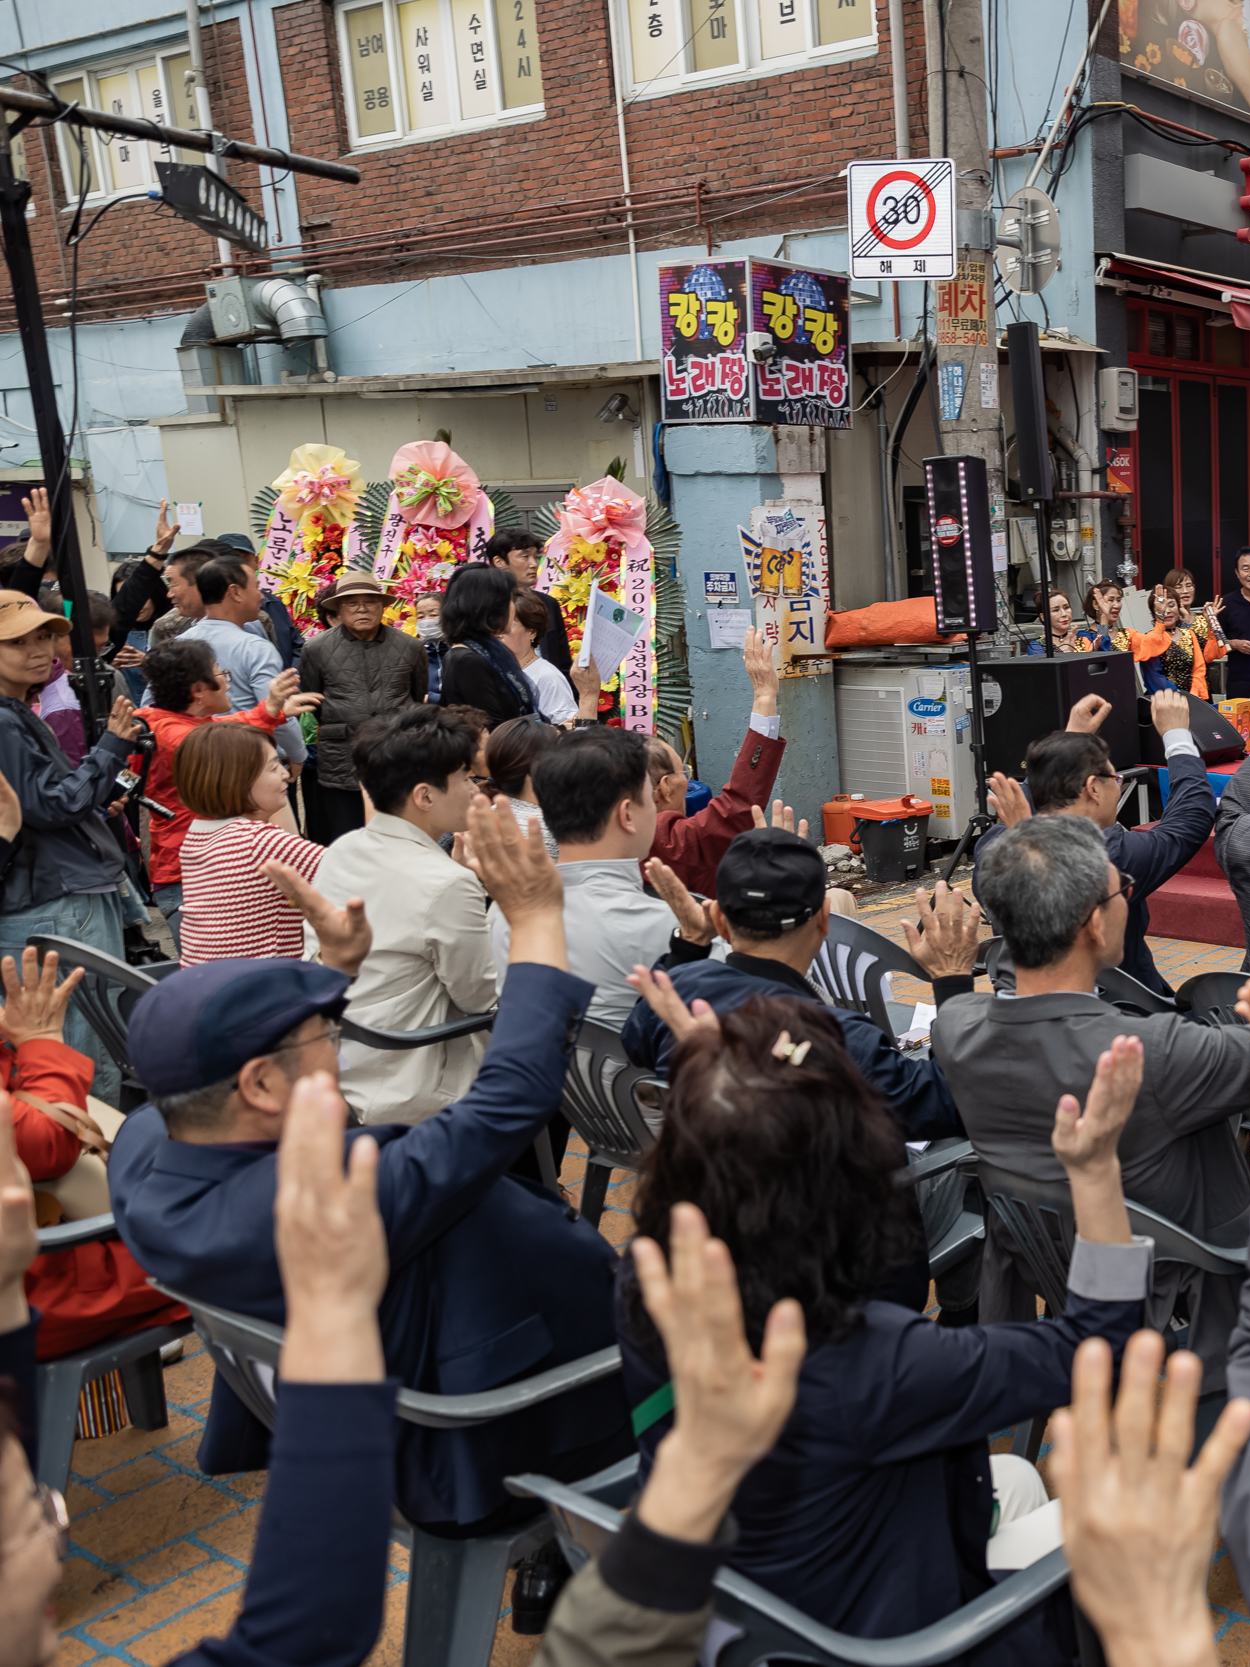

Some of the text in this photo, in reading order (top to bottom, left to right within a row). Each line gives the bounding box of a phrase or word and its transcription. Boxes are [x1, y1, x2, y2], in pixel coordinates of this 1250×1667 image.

[357, 33, 384, 58] 남여
[468, 13, 487, 91] 수면실
[513, 0, 531, 79] 24시
[415, 26, 434, 102] 샤워실
[363, 86, 389, 111] 공용
[882, 195, 921, 225] 30
[937, 282, 987, 330] 폐차
[380, 513, 407, 559] 광진구
[626, 558, 650, 573] 祝
[705, 581, 737, 593] 주차금지
[912, 701, 943, 714] Carrier
